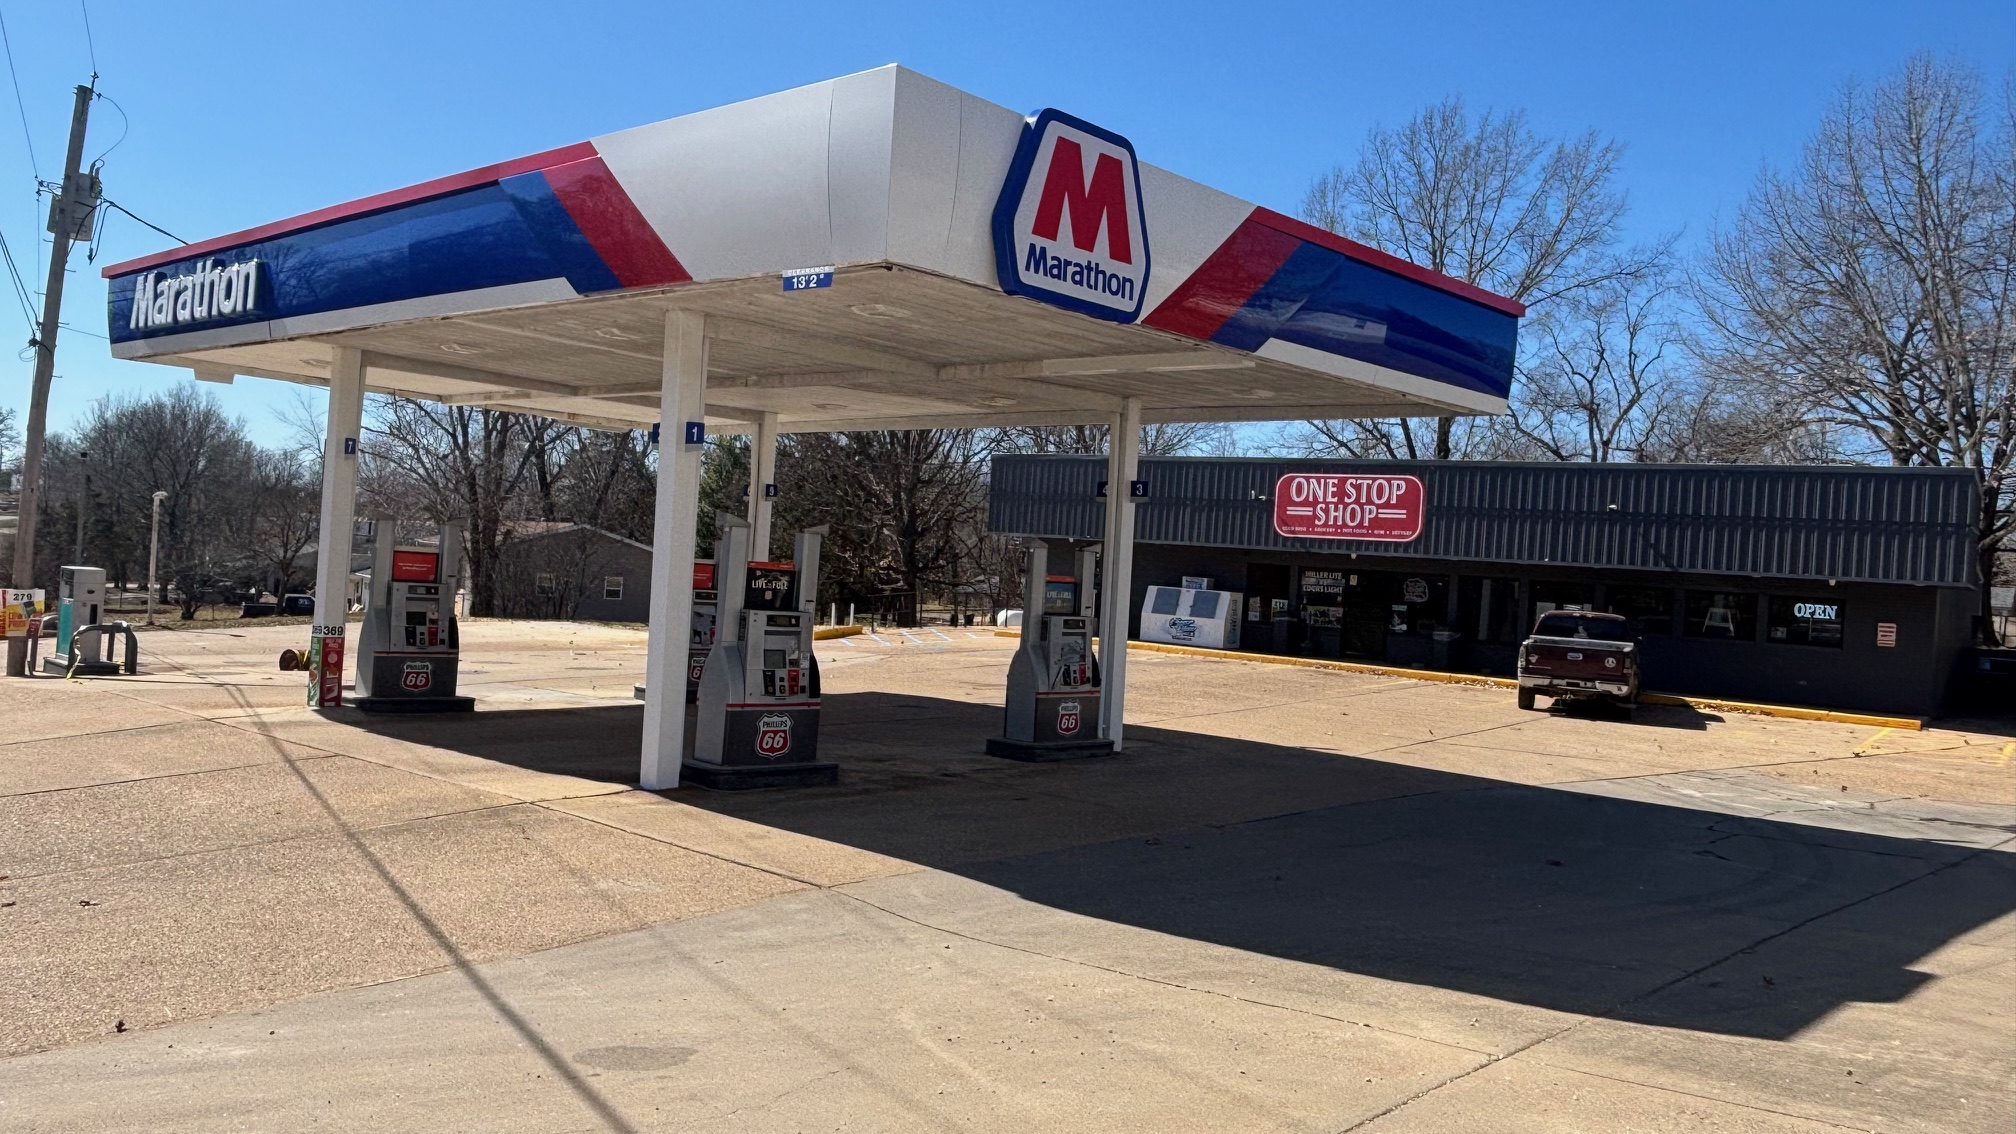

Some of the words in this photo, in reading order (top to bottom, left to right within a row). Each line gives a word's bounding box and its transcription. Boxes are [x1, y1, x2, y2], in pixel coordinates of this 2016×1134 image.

[1031, 136, 1133, 265] M
[1025, 243, 1135, 301] Marathon
[130, 257, 258, 329] Marathon
[692, 426, 699, 441] 1
[1136, 483, 1143, 495] 3
[1290, 477, 1338, 502] ONE
[1344, 478, 1406, 504] STOP
[1315, 504, 1377, 526] SHOP
[752, 580, 767, 589] LIVE
[1793, 603, 1838, 619] OPEN
[323, 626, 344, 636] 369
[406, 673, 427, 686] 66
[762, 719, 788, 728] PHILLIPS
[1061, 715, 1076, 729] 66
[762, 732, 785, 749] 66
